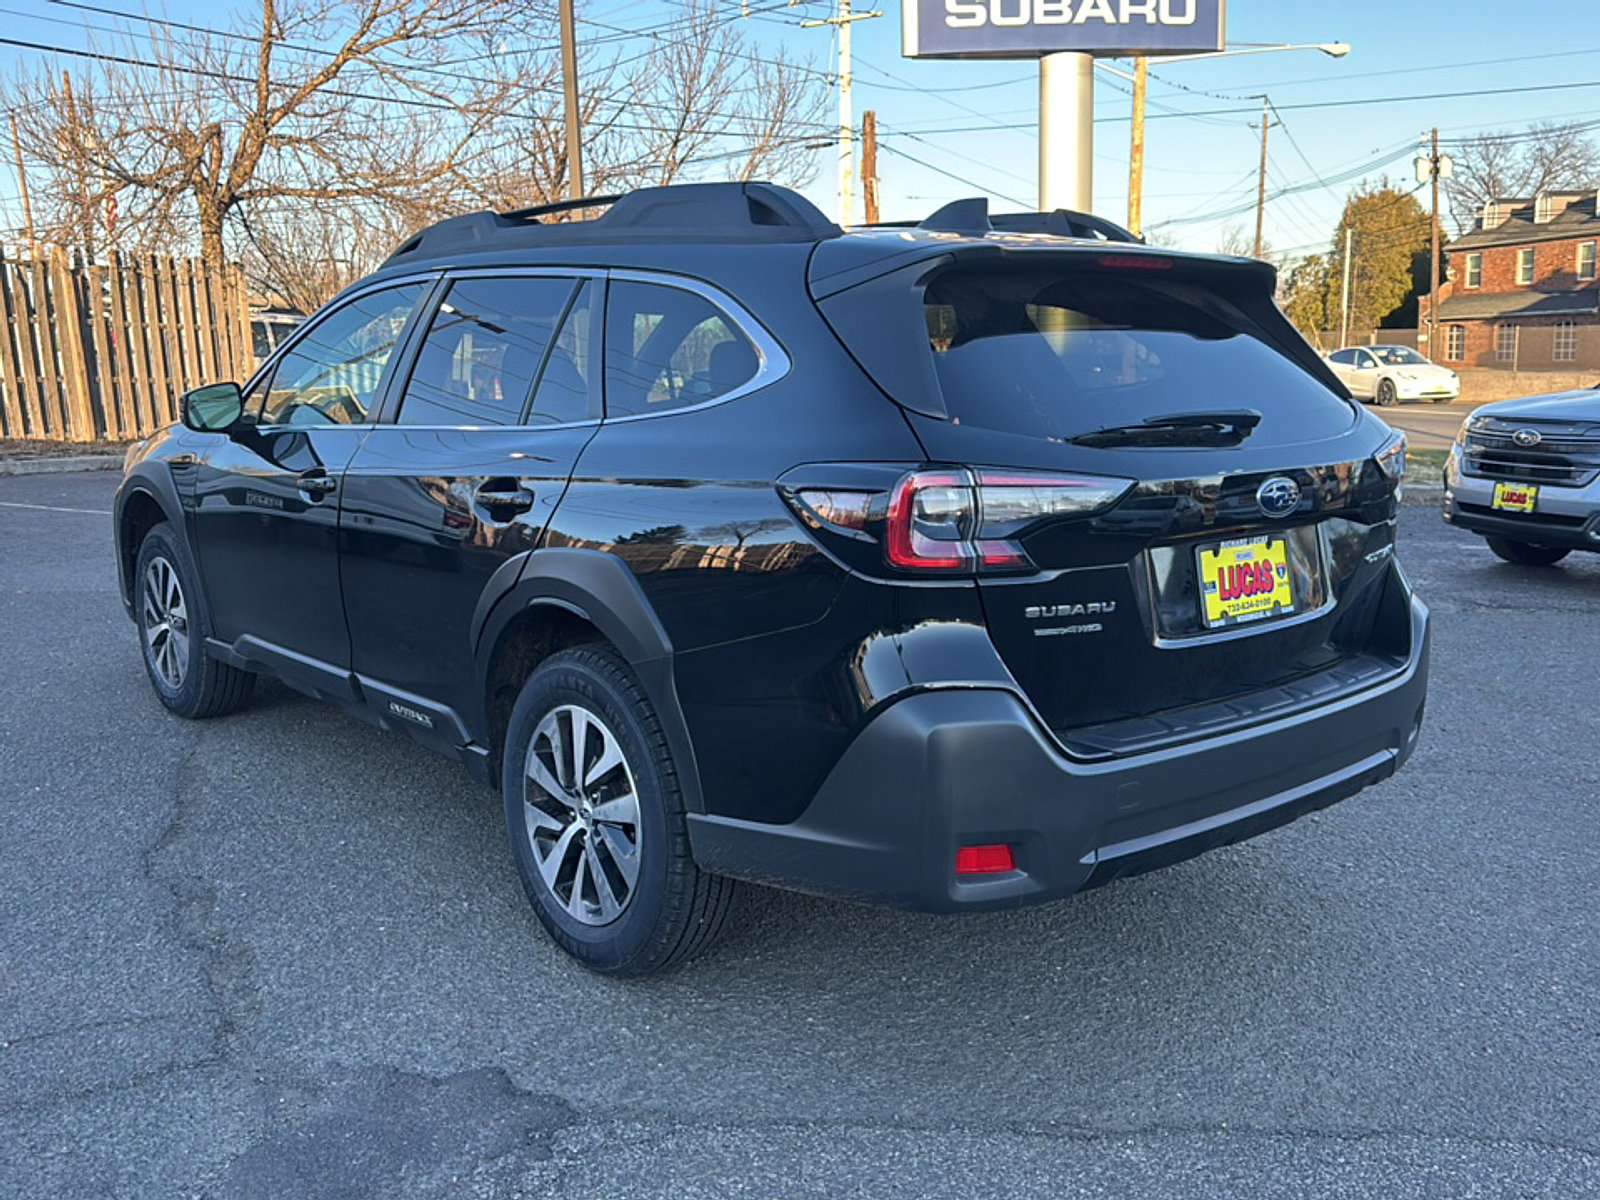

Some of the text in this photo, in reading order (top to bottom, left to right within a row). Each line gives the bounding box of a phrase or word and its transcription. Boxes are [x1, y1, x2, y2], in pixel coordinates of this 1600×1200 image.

[945, 0, 1196, 28] SUBARU
[1218, 559, 1275, 601] LUCAS
[1025, 601, 1116, 618] SUBARU
